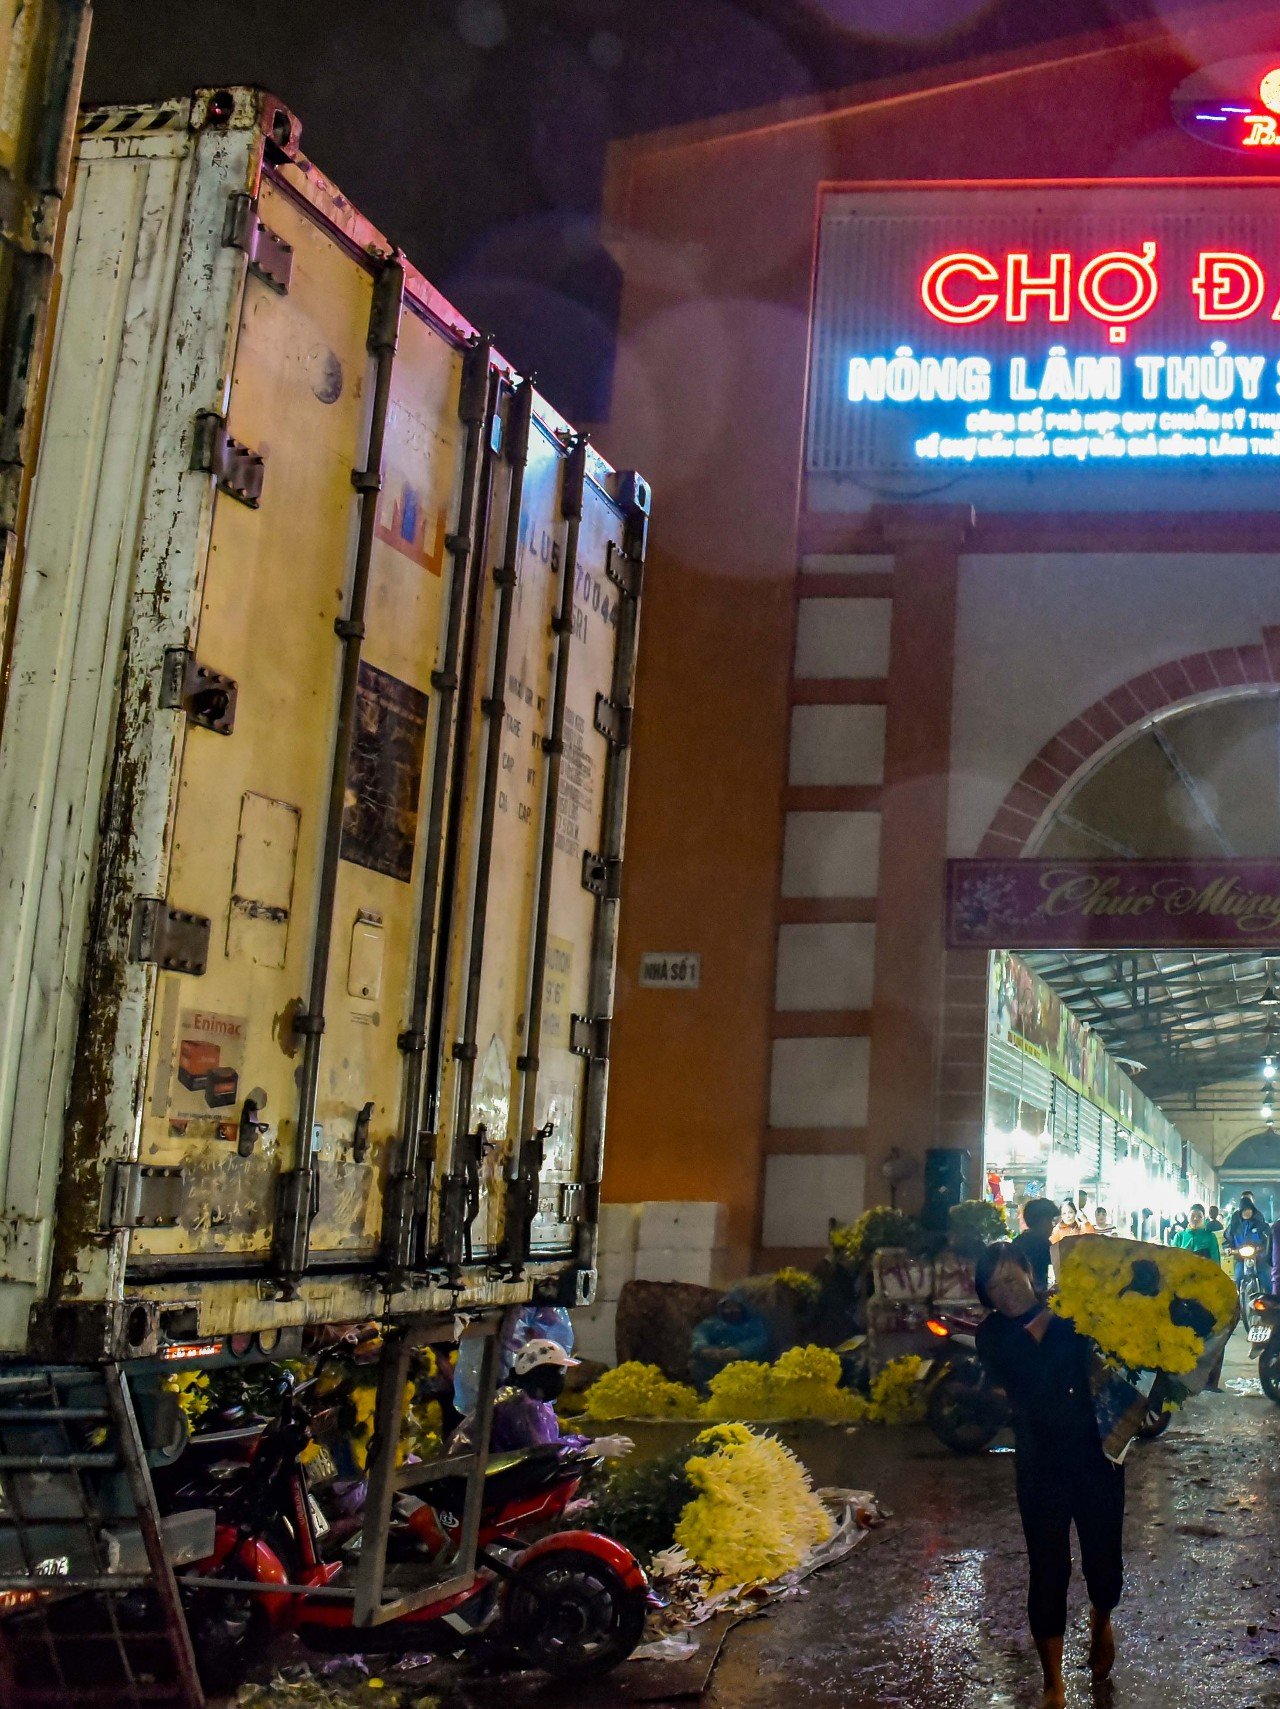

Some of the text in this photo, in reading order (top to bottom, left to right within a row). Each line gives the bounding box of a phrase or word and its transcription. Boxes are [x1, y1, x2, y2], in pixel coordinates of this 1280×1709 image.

[920, 241, 1160, 344] CHỢ
[848, 345, 990, 401] NÔNG
[1010, 345, 1121, 400] LÂM
[1136, 341, 1265, 400] THỦY
[1039, 868, 1156, 917] Chúc
[670, 955, 688, 981] SỐ
[690, 963, 696, 980] 1
[193, 1013, 242, 1037] Enimac
